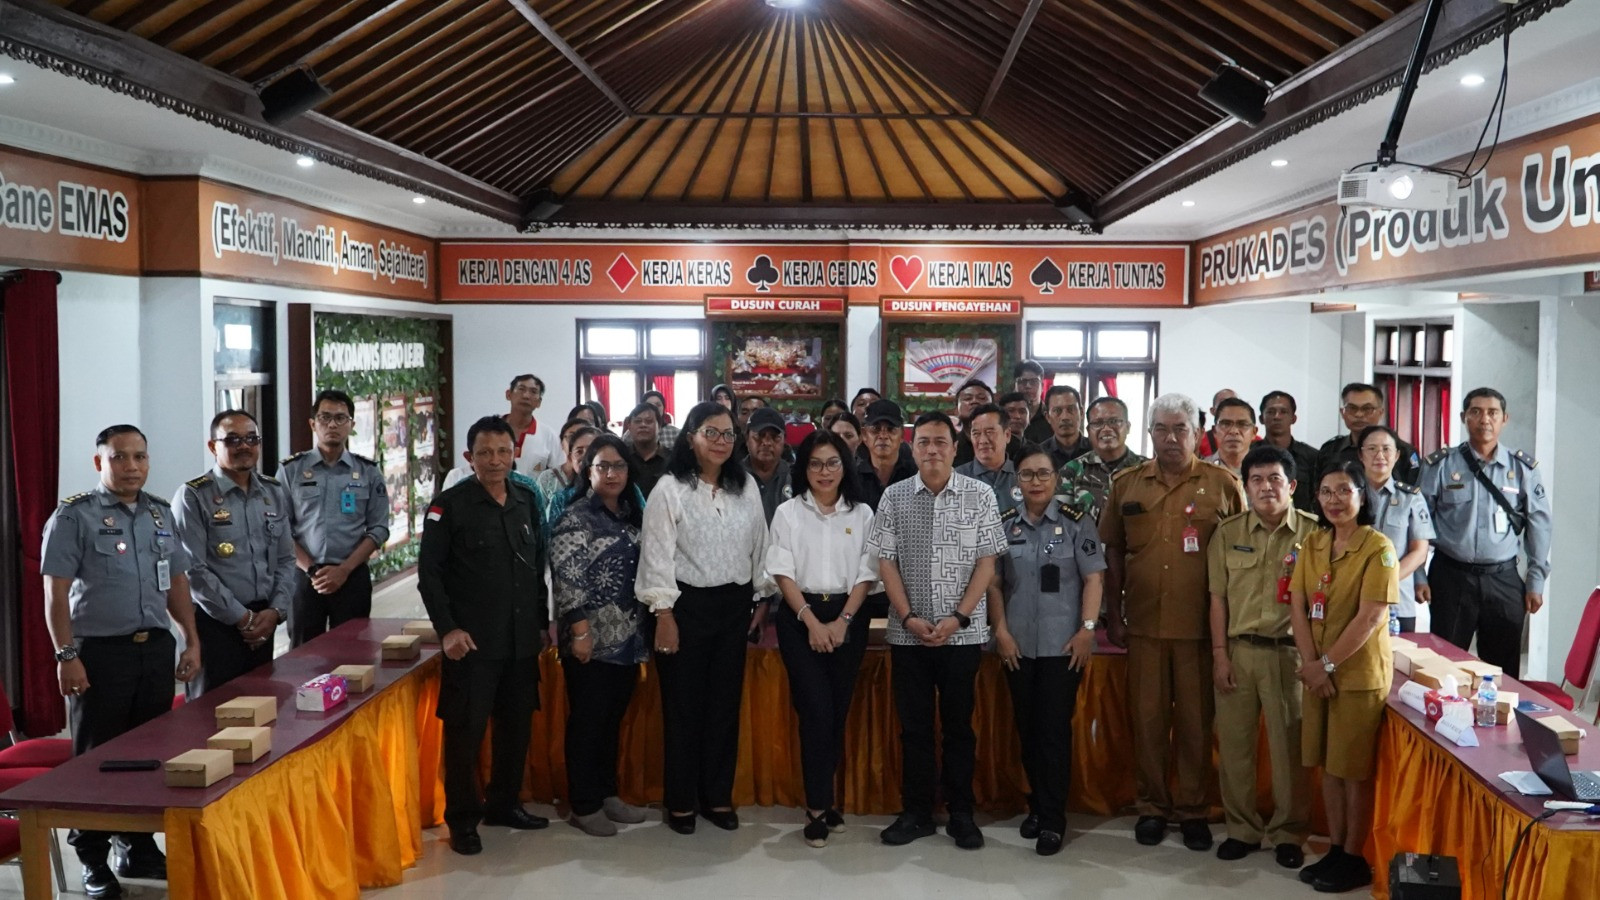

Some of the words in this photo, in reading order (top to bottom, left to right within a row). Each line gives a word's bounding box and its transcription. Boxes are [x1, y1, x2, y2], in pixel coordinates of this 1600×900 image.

[0, 176, 53, 229] ane
[60, 185, 127, 239] EMAS
[213, 204, 280, 262] (Efektif,
[283, 216, 338, 272] Mandiri,
[341, 235, 377, 277] Aman,
[379, 241, 428, 287] Sejahtera)
[1201, 221, 1325, 286] PRUKADES
[459, 260, 501, 285] KERJA
[504, 260, 558, 285] DENGAN
[562, 260, 572, 285] 4
[573, 260, 591, 285] AS
[643, 260, 683, 286] KERJA
[687, 260, 732, 286] KERAS
[783, 260, 825, 286] KERJA
[928, 261, 970, 288] KERJA
[973, 261, 1013, 288] IKLAS
[1068, 263, 1110, 289] KERJA
[1113, 263, 1165, 289] TUNTAS
[730, 299, 775, 311] DUSUN
[778, 299, 821, 311] CURAH
[891, 300, 933, 312] DUSUN
[935, 301, 1012, 313] PENGAYEHAN
[322, 341, 380, 372] POKDARWIS
[381, 341, 403, 370] KEBO
